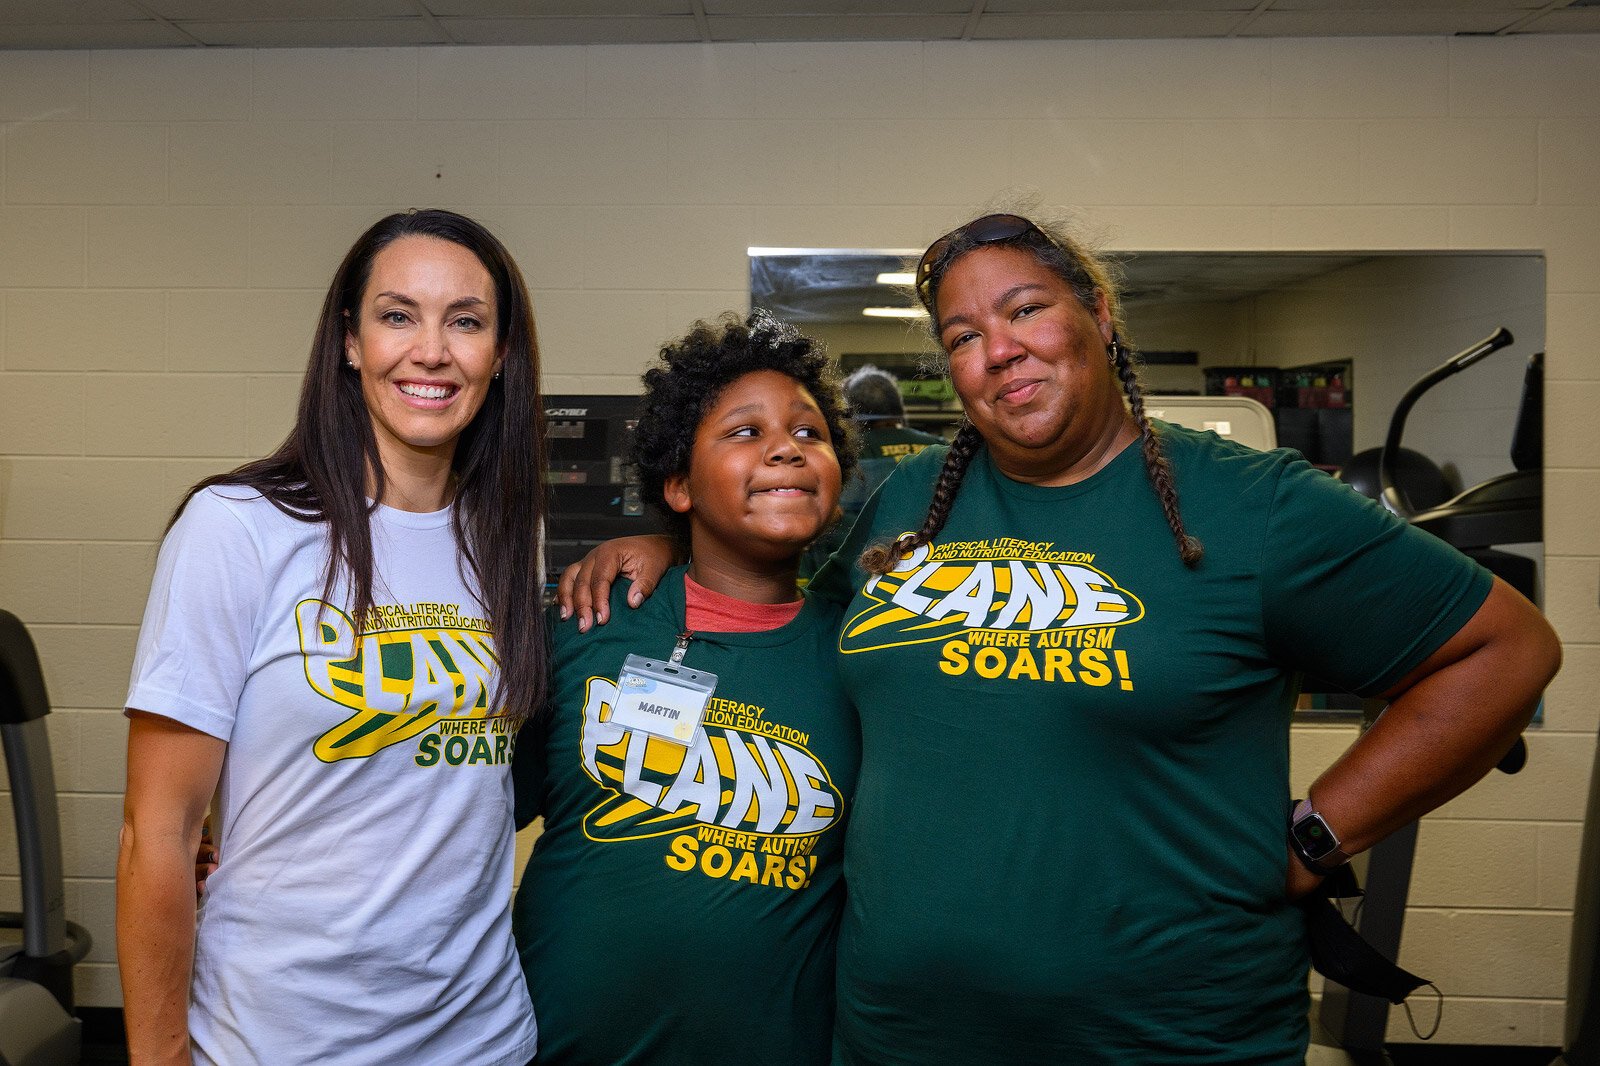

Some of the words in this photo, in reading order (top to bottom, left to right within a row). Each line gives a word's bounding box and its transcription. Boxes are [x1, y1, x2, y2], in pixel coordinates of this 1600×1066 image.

[932, 548, 958, 560] AND
[959, 546, 1020, 560] NUTRITION
[1023, 548, 1096, 563] EDUCATION
[935, 540, 991, 552] PHYSICAL
[992, 537, 1054, 551] LITERACY
[410, 603, 460, 616] LITERACY
[384, 615, 441, 629] NUTRITION
[444, 616, 495, 631] EDUCATIO
[968, 630, 1031, 647] WHERE
[1037, 628, 1117, 649] AUTISM
[296, 599, 508, 717] PLAN
[939, 640, 1134, 692] SOARS!
[638, 701, 681, 720] MARTIN
[707, 697, 765, 718] ITERACY
[439, 721, 487, 735] WHERE
[737, 715, 810, 746] EDUCATION
[698, 827, 758, 851] WHERE
[760, 836, 820, 856] AUTISM
[666, 834, 818, 891] SOARS!
